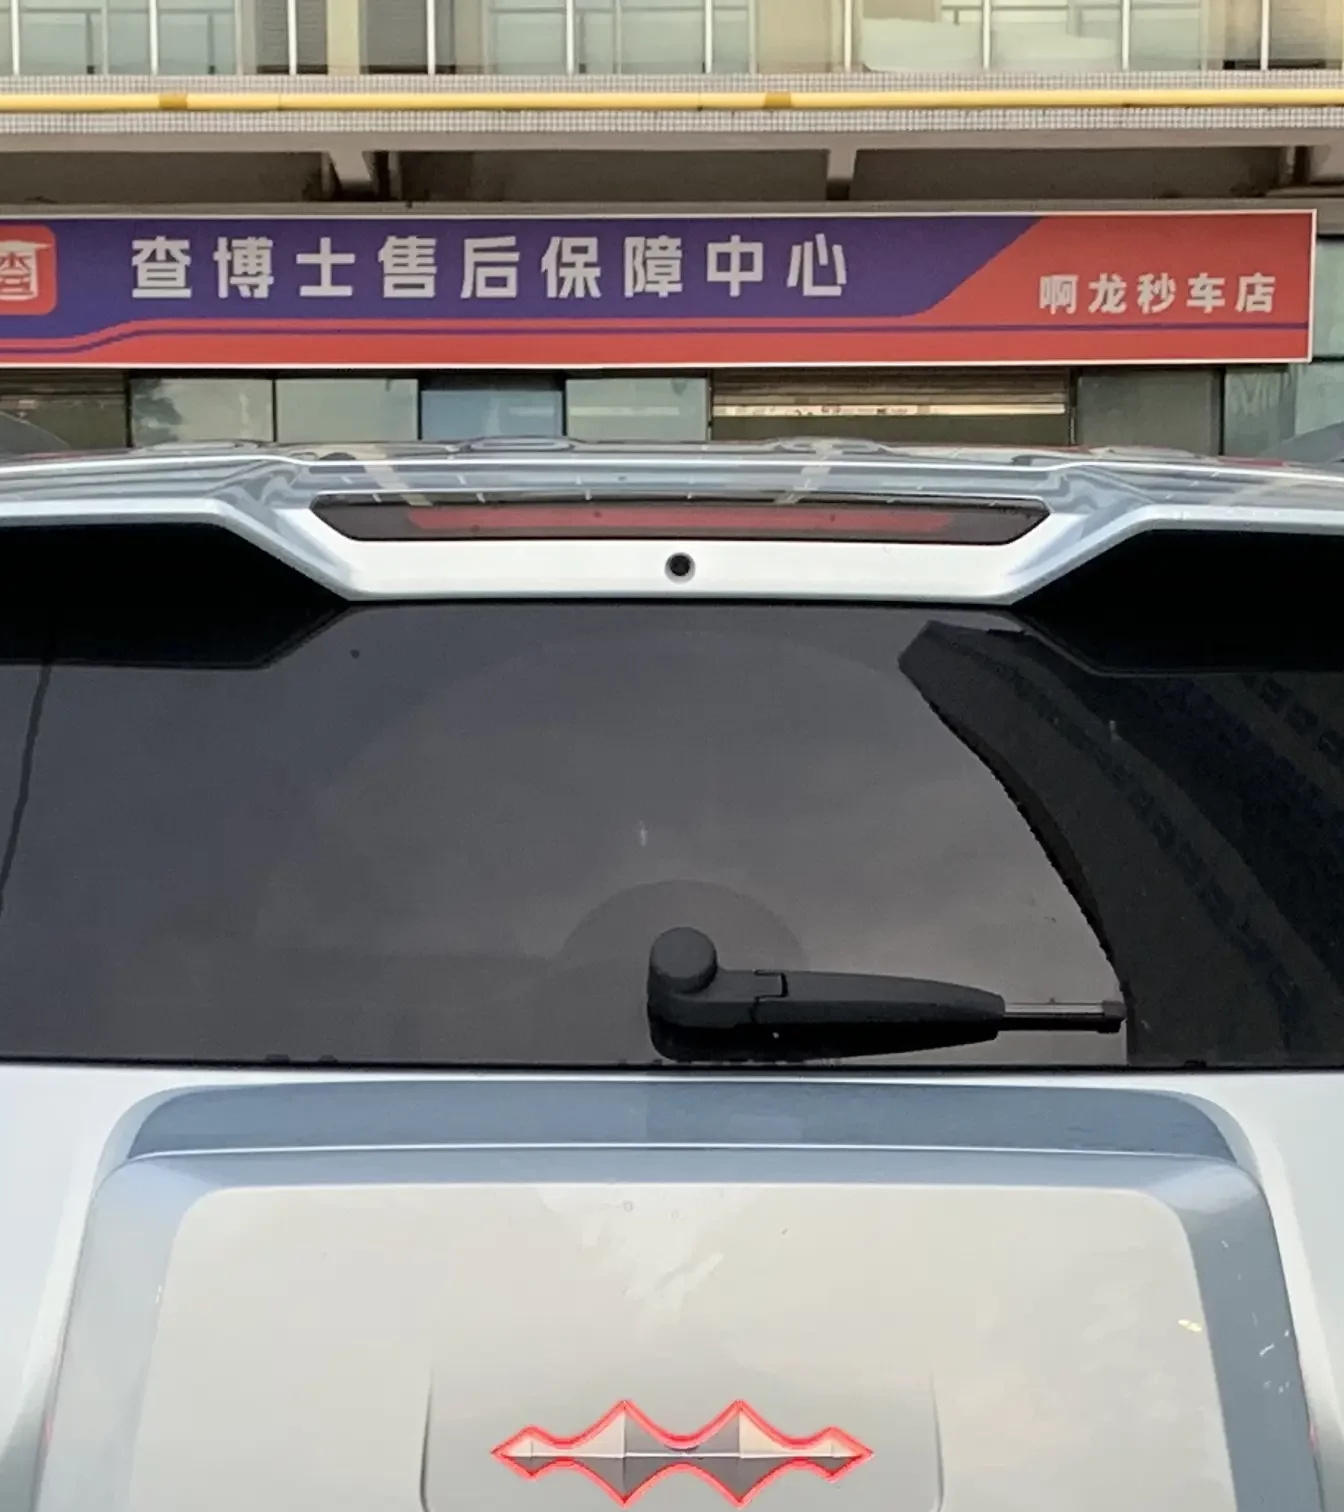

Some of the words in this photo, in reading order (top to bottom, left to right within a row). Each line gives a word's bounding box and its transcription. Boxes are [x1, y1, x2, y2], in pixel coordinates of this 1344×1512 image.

[131, 233, 847, 299] 查博士售后保障中心
[1039, 272, 1276, 314] 啊龙秒车店
